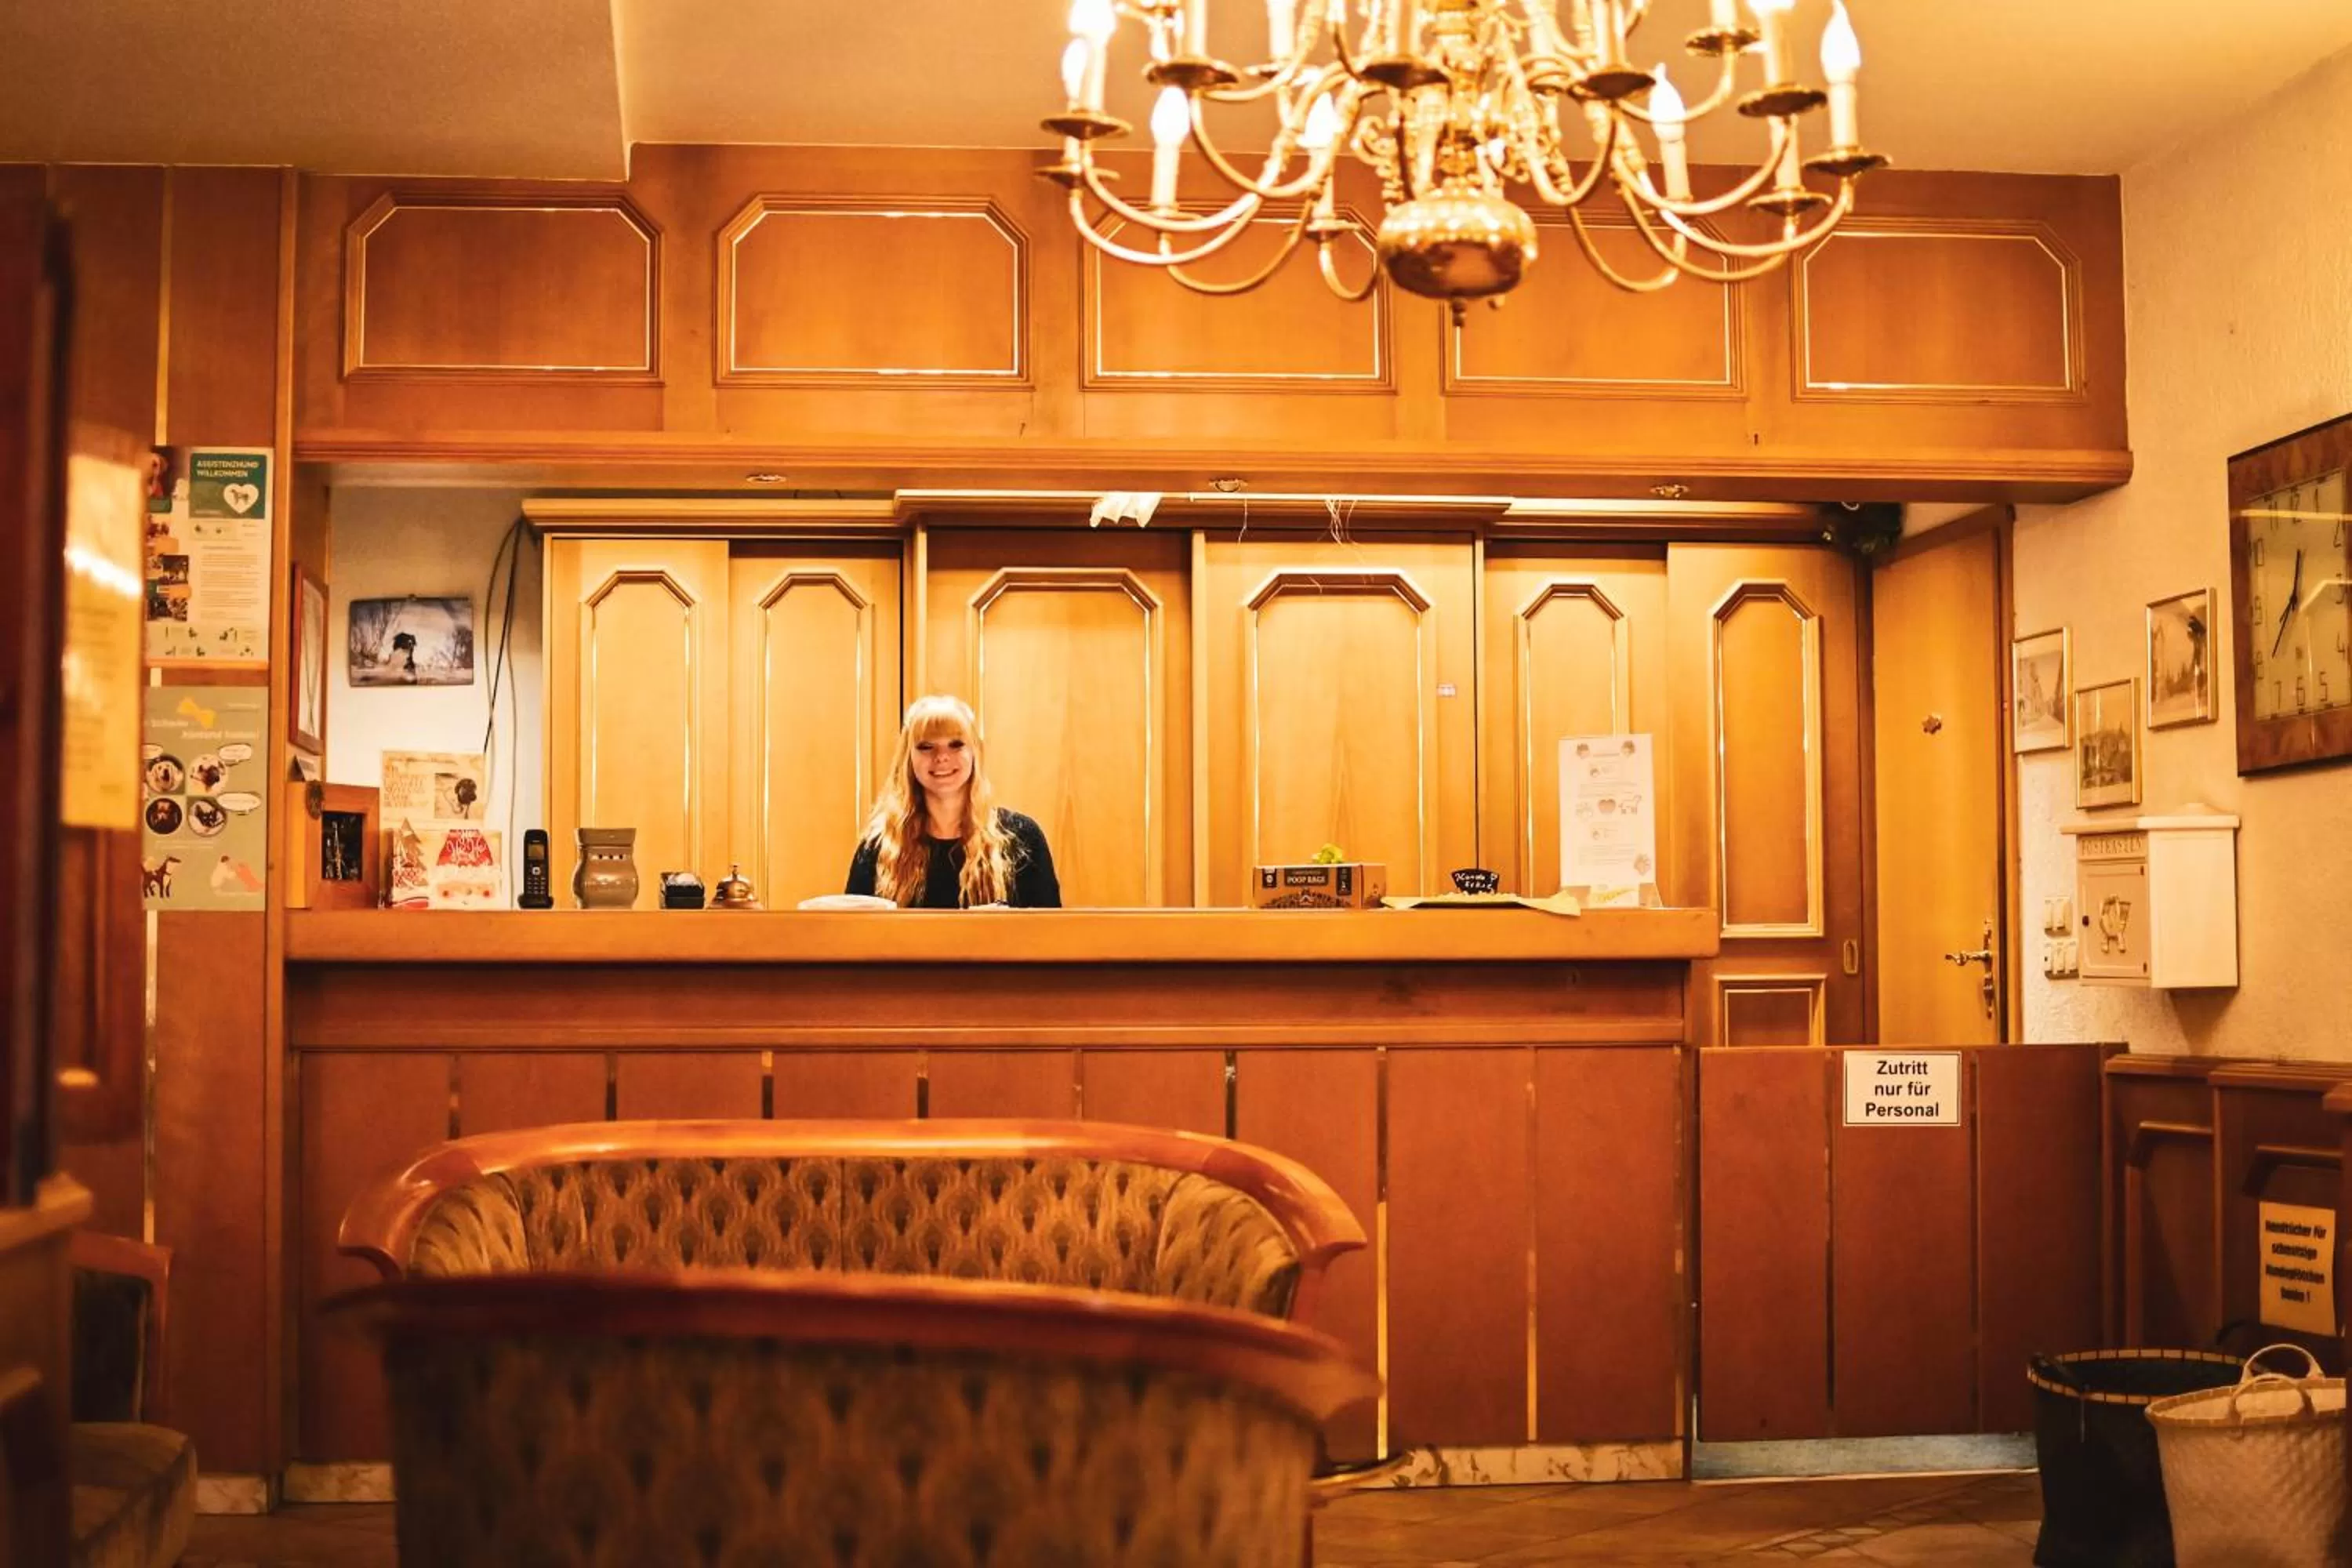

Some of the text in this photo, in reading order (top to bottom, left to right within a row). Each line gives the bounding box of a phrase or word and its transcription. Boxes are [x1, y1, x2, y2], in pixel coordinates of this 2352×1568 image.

[197, 469, 249, 477] WILLKOMMEN
[2296, 676, 2306, 706] 6
[2318, 670, 2328, 702] 5
[1876, 1060, 1928, 1075] Zutritt
[1875, 1081, 1931, 1096] nur für
[1865, 1102, 1940, 1117] Personal
